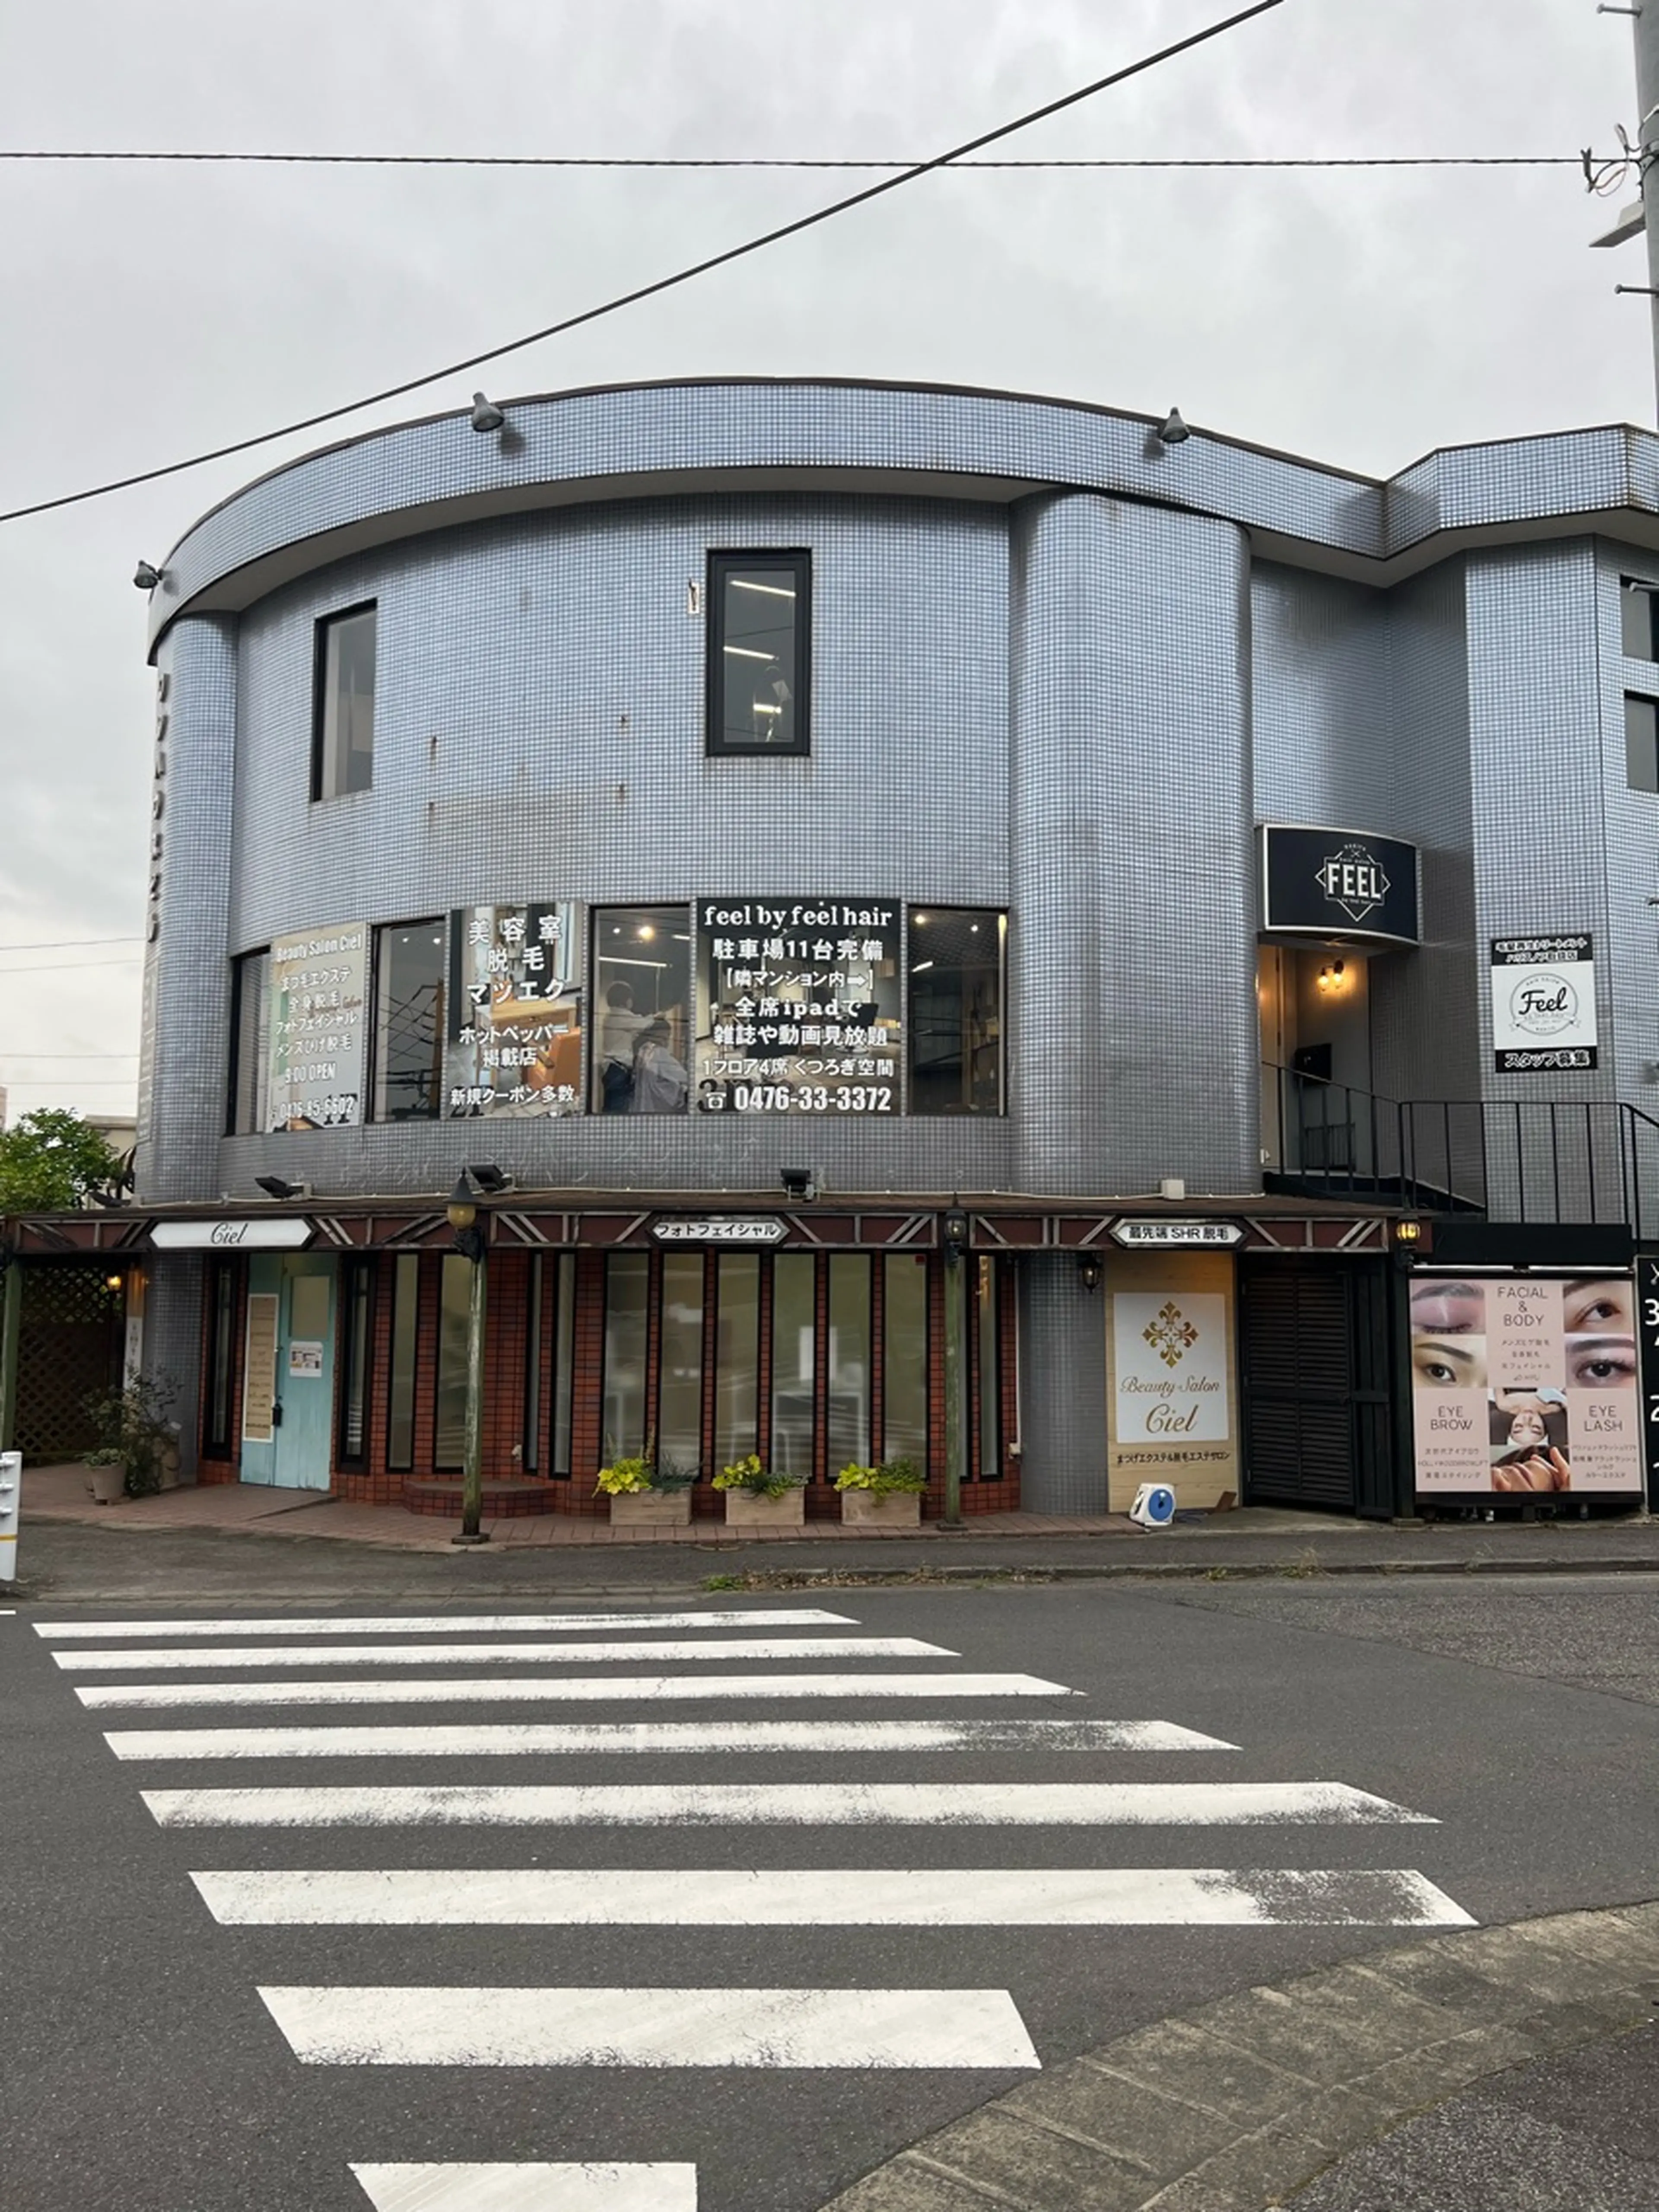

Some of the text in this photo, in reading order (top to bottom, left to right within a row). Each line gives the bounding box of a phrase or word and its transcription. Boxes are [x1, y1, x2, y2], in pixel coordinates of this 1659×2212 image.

[1328, 863, 1381, 899] FEEL
[704, 906, 893, 929] feel by feel hair
[469, 915, 562, 945] 美容室
[486, 945, 546, 973] 脱毛
[712, 938, 883, 960] 駐車場11台完備
[467, 978, 565, 1004] マツエク
[1518, 987, 1568, 1015] Feel
[459, 1024, 569, 1044] ホットペッパー
[714, 1025, 888, 1046] 雑誌や動画見放題
[483, 1047, 538, 1068] 掲載店
[308, 1062, 336, 1081] OPEN
[450, 1085, 575, 1106] 新規クーポン多数
[735, 1086, 891, 1111] 0476-33-3372
[210, 1222, 248, 1244] Ciel
[657, 1224, 778, 1236] フォトフェイシャル
[1171, 1227, 1200, 1239] SHR
[1497, 1286, 1549, 1299] FACIAL
[1518, 1300, 1527, 1313] &
[1503, 1313, 1545, 1326] BODY
[1120, 1375, 1220, 1399] Beauty Salon
[1146, 1403, 1199, 1434] Ciel
[1438, 1405, 1464, 1417] EYE
[1589, 1405, 1617, 1417] EYE
[1430, 1419, 1473, 1430] BROW
[1584, 1419, 1623, 1432] LASH
